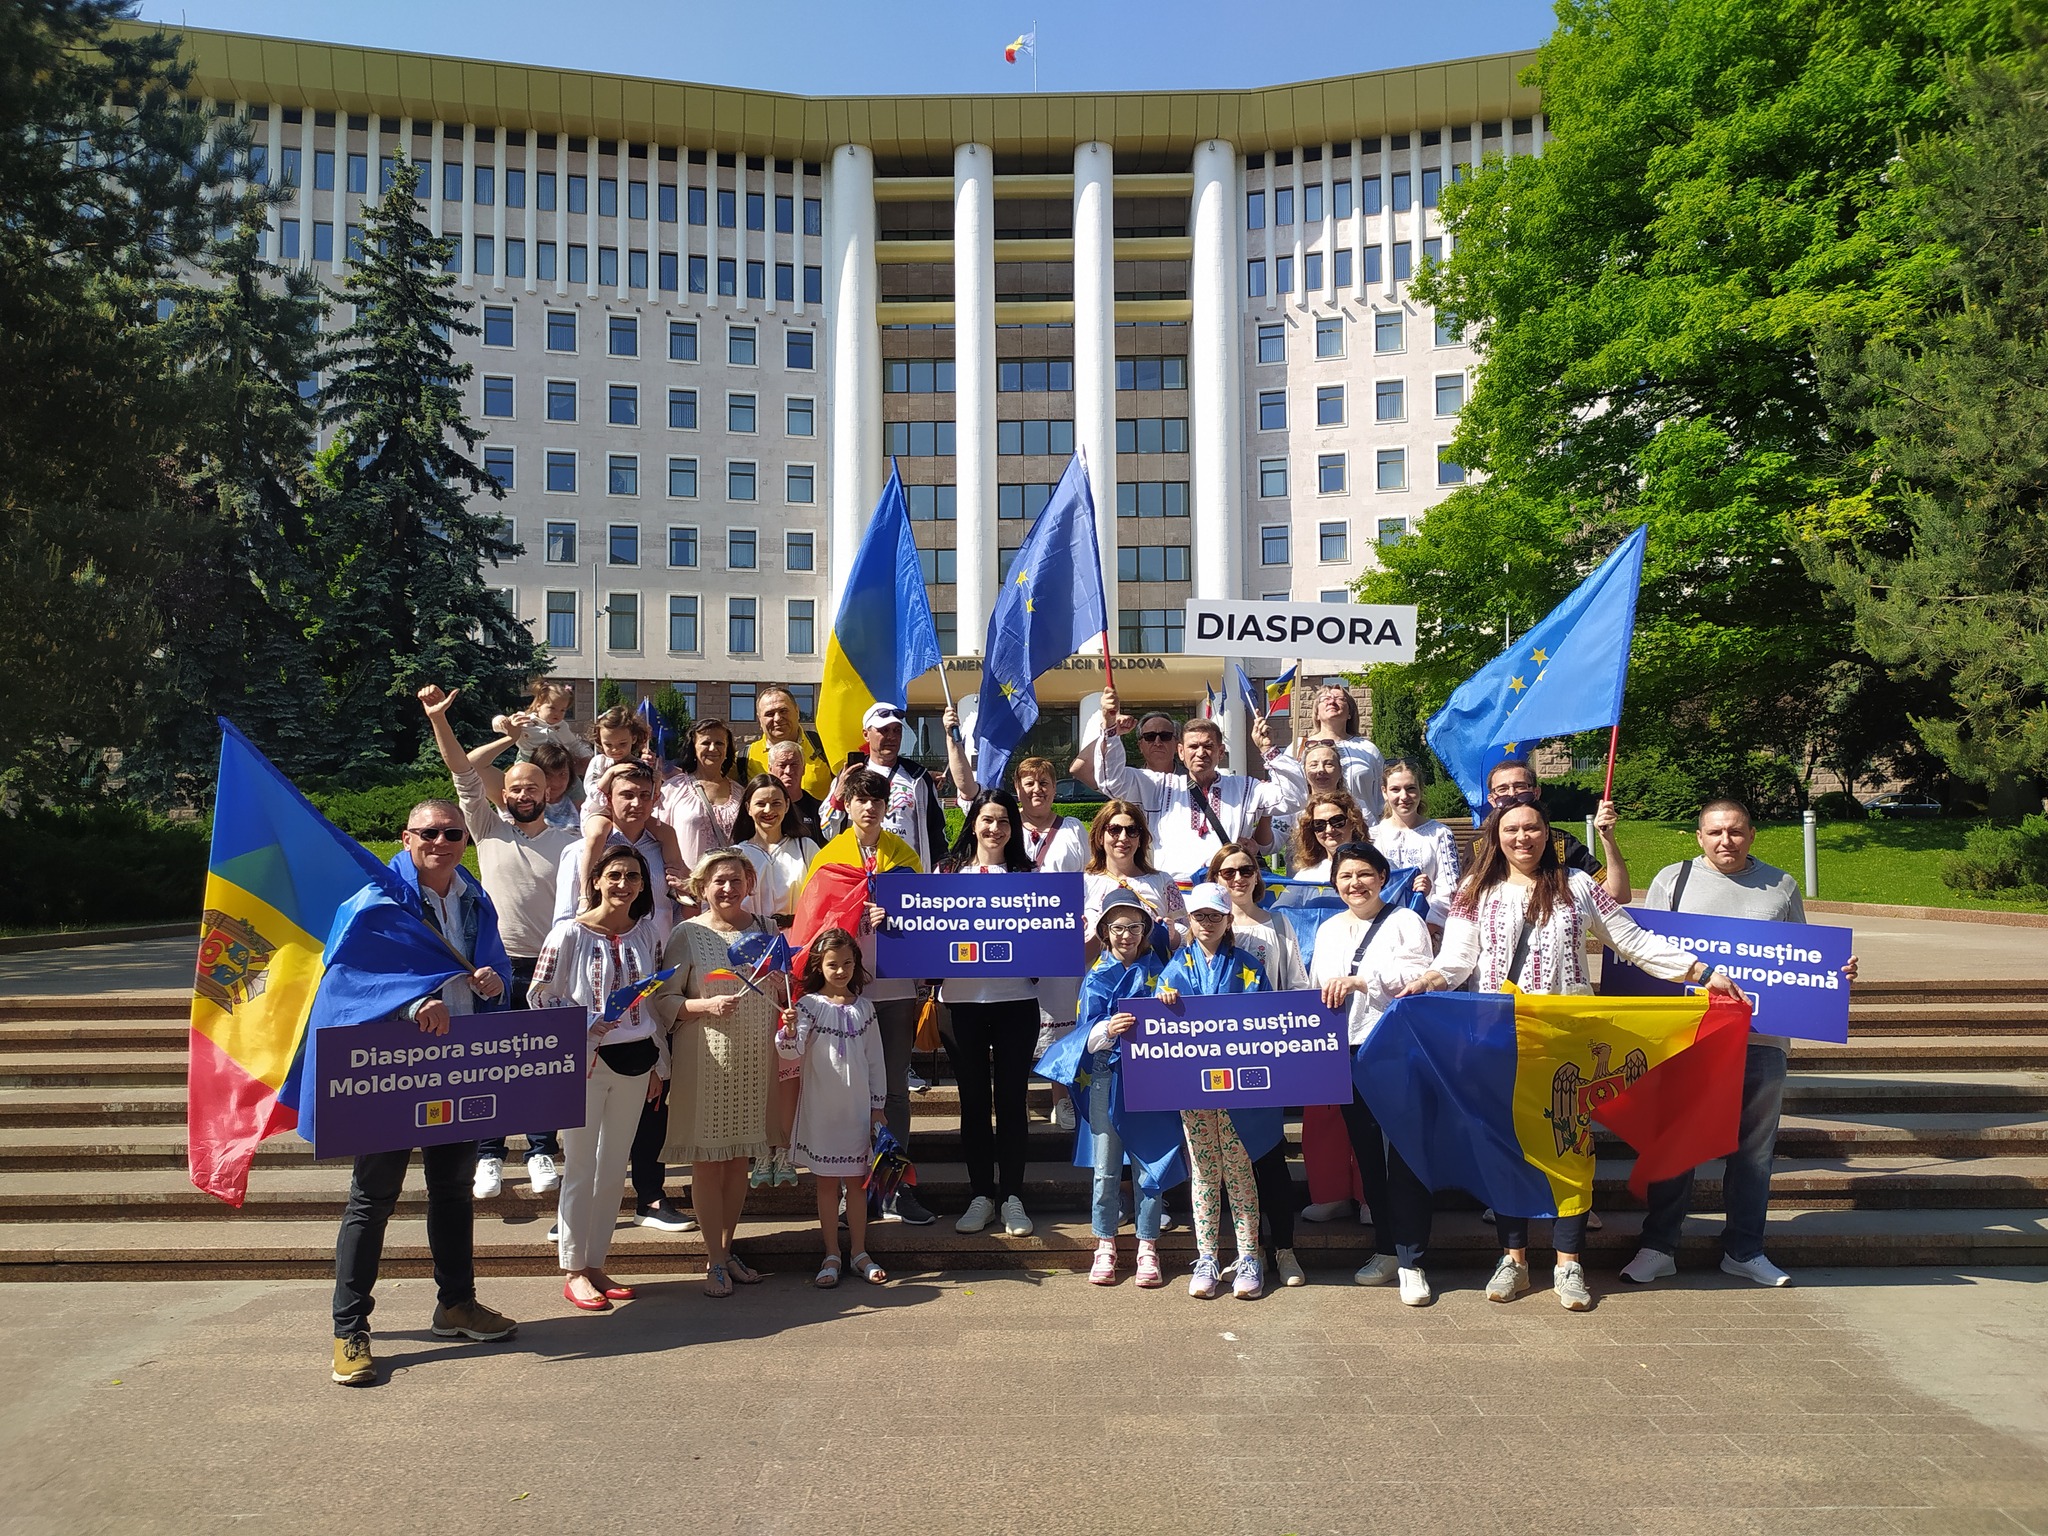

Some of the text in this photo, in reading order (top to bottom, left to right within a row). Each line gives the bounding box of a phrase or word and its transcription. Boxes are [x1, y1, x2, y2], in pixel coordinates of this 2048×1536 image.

[1197, 612, 1402, 646] DIASPORA
[901, 892, 1061, 914] Diaspora susține
[886, 912, 1076, 934] Moldova europeană
[1735, 943, 1822, 967] susține
[1714, 963, 1839, 990] europeană
[1145, 1011, 1321, 1038] Diaspora susține
[350, 1032, 559, 1069] Diaspora susține
[1130, 1032, 1339, 1060] Moldova europeană
[329, 1053, 576, 1098] Moldova europeană
